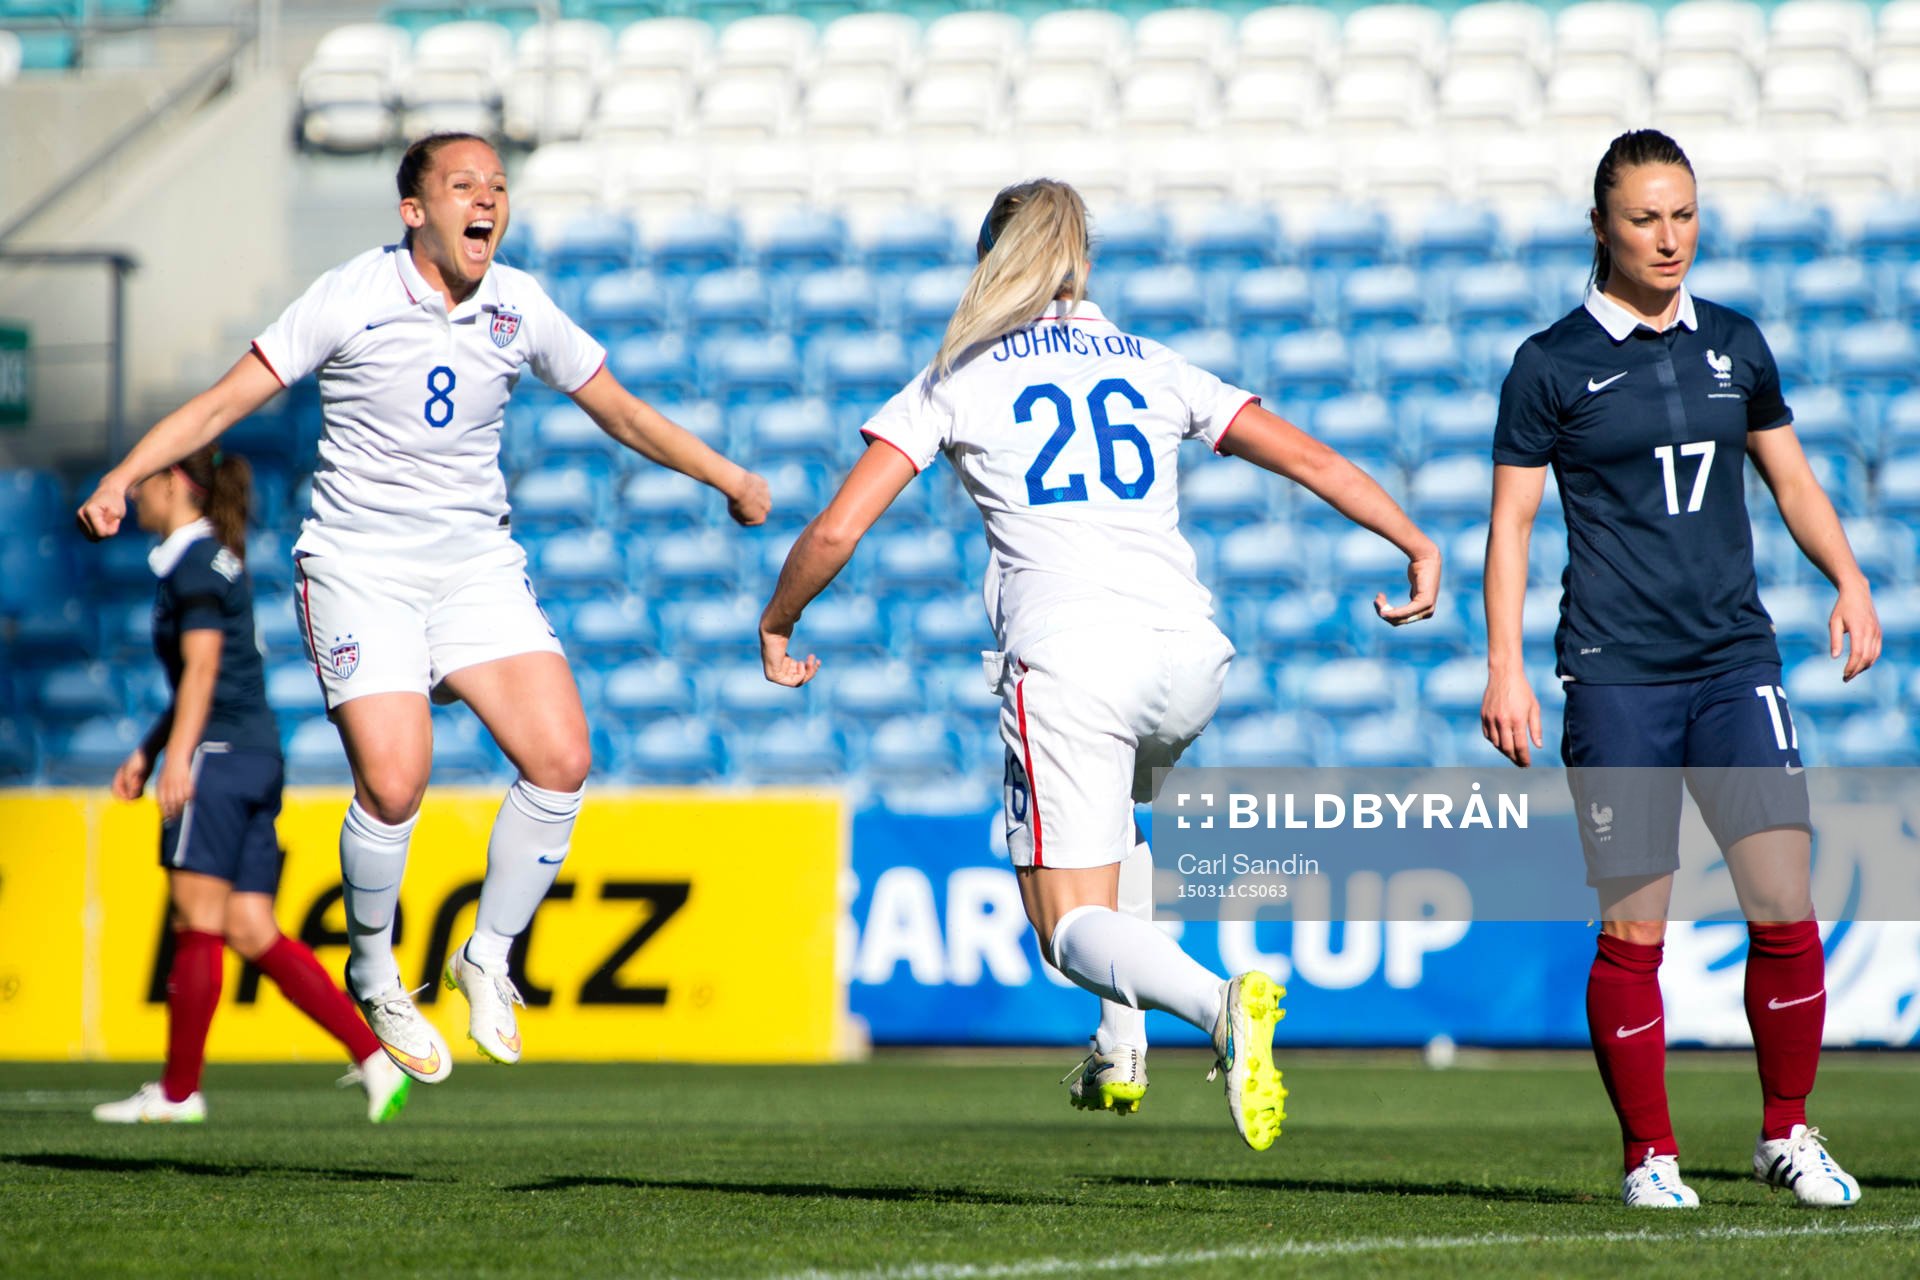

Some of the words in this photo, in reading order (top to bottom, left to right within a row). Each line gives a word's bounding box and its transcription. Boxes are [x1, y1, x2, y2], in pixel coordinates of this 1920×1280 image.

[993, 325, 1145, 361] JOHNSTON
[424, 366, 456, 428] 8
[1012, 378, 1155, 505] 26
[1654, 440, 1716, 515] 17
[1004, 748, 1028, 823] 6
[1218, 868, 1474, 990] CUP
